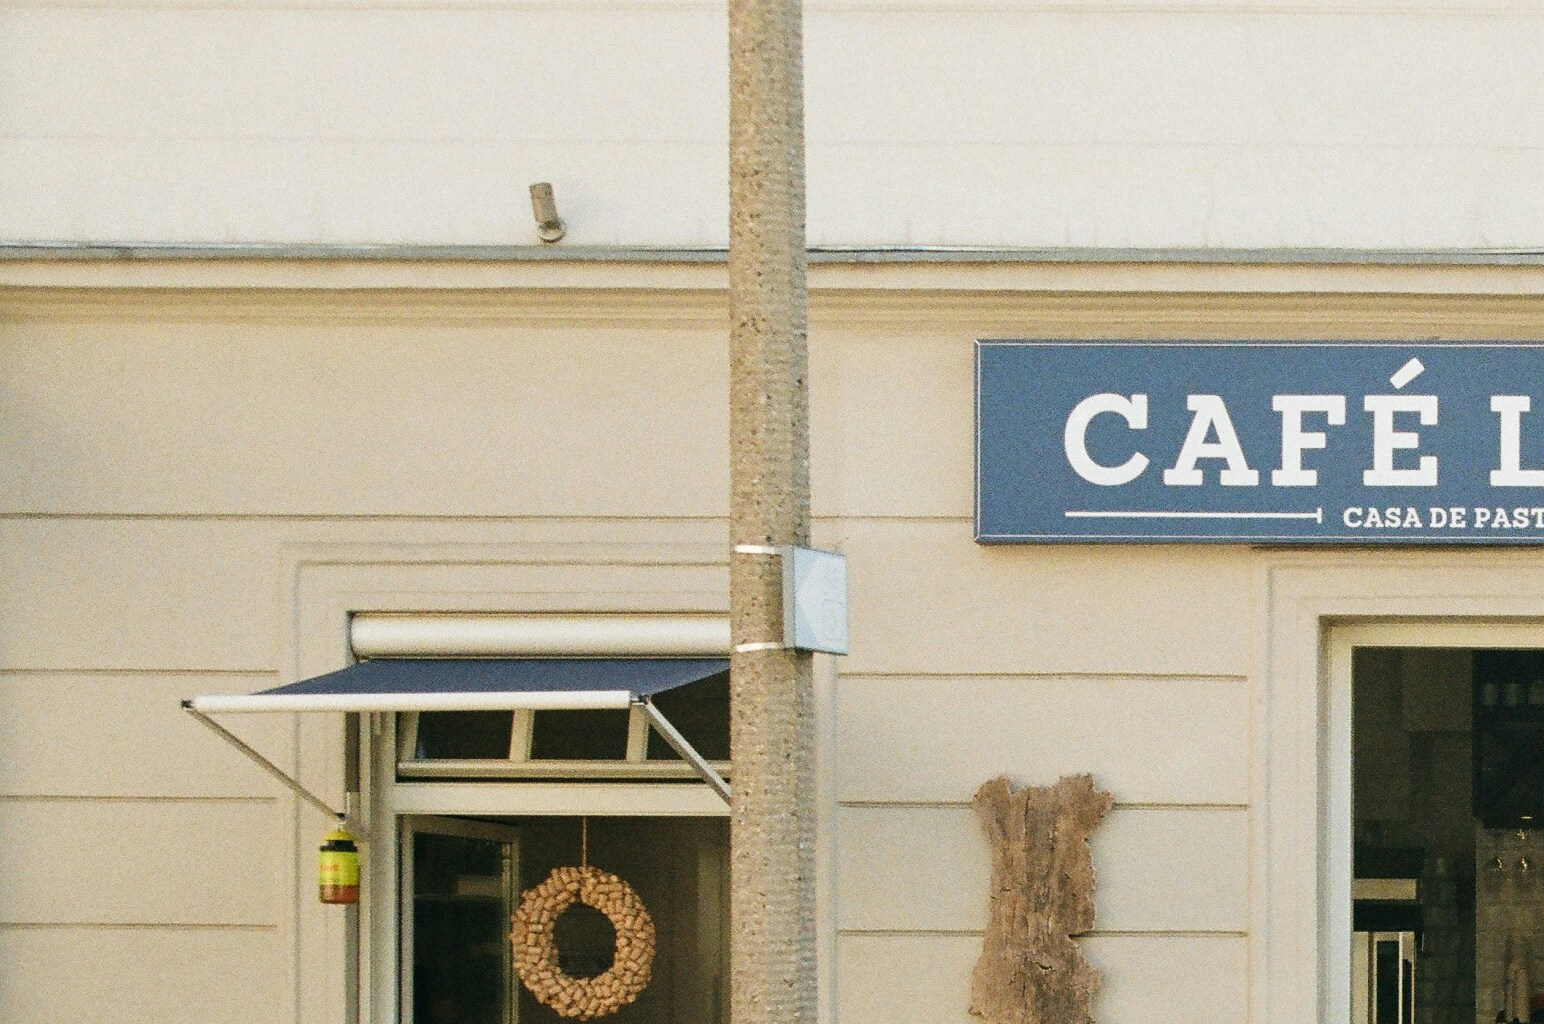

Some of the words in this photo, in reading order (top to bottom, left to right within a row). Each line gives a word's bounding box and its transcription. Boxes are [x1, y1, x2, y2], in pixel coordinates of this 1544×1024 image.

[1063, 357, 1440, 487] CAFÉ
[1343, 506, 1423, 529] CASA
[1429, 507, 1466, 529] DE
